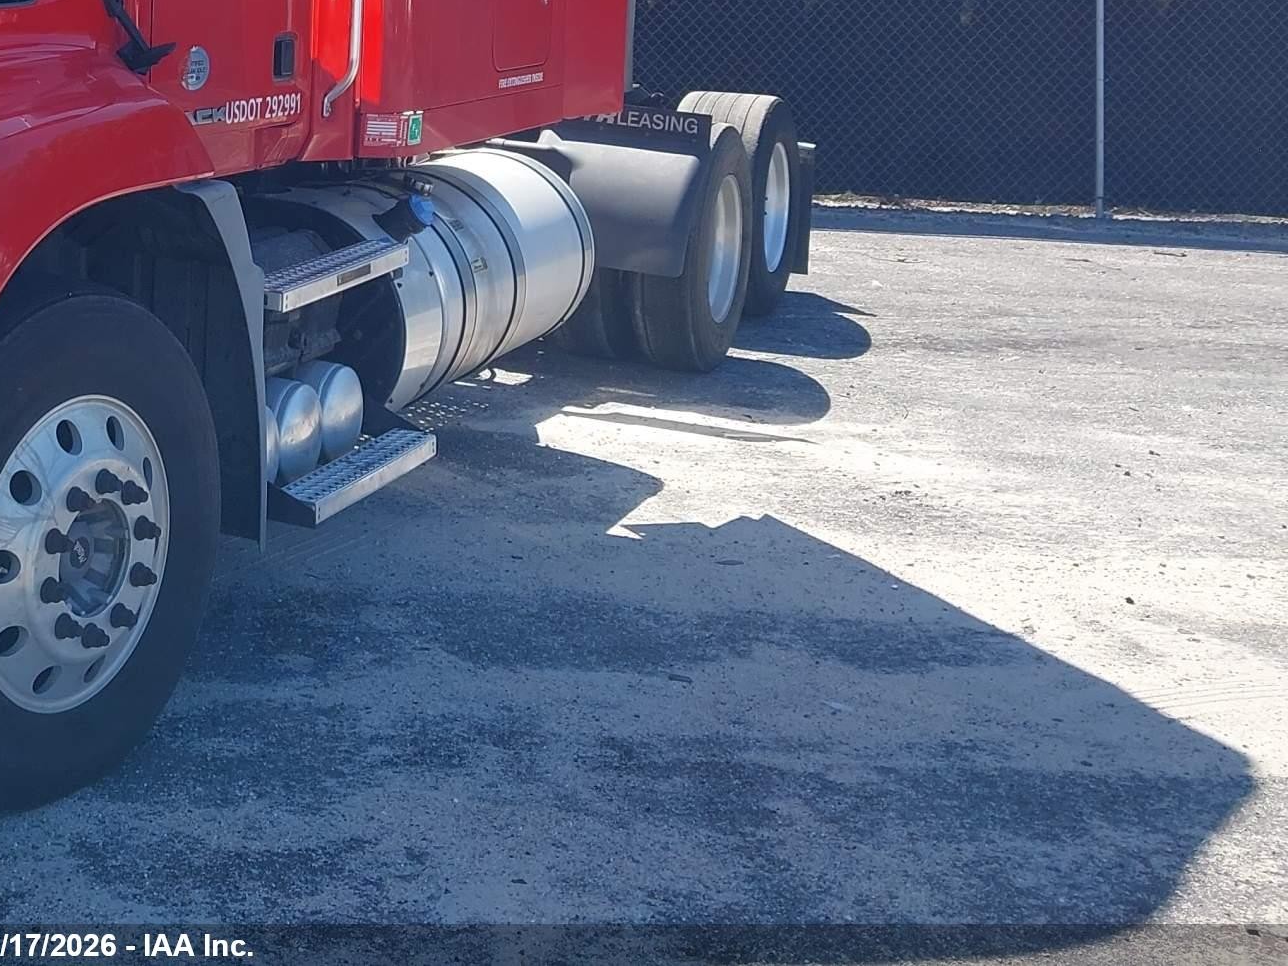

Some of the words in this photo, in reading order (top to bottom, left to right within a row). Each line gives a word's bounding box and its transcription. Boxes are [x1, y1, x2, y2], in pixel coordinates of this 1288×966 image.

[225, 98, 263, 124] USDOT
[265, 93, 301, 118] 292991
[617, 111, 698, 134] LEASING
